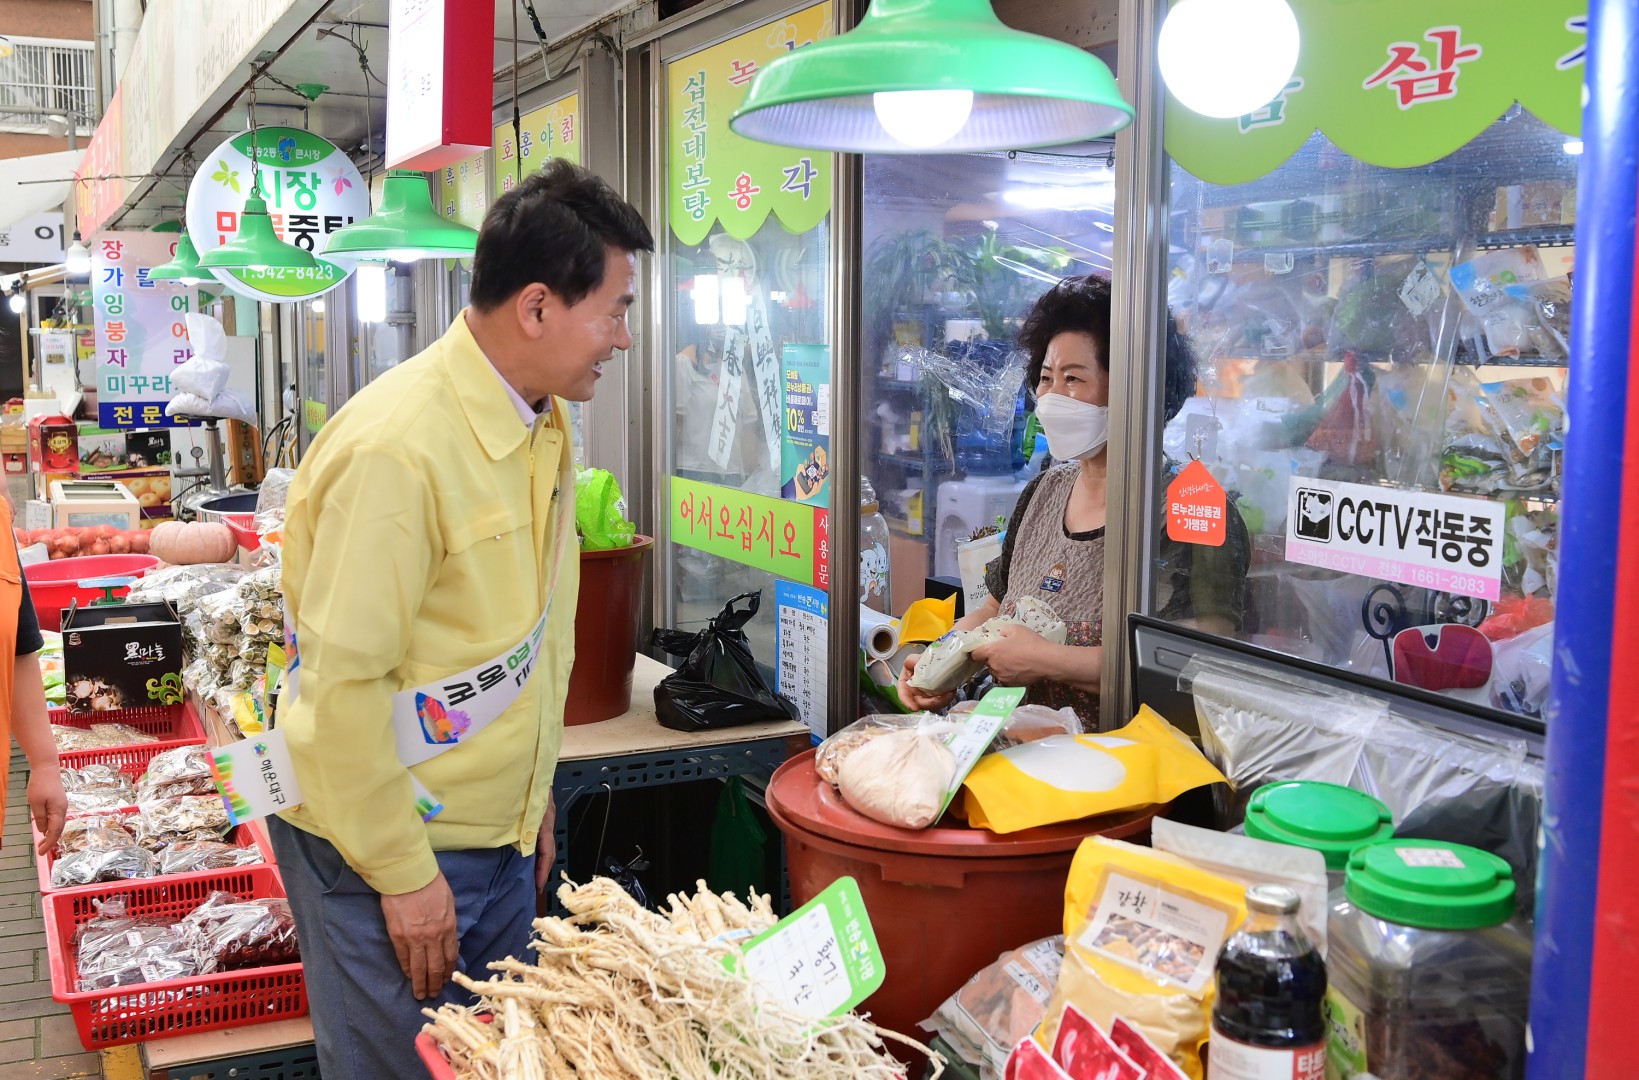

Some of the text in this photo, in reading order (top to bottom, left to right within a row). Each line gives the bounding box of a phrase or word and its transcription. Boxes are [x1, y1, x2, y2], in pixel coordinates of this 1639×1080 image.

[1366, 30, 1479, 106] 삼
[682, 71, 710, 219] 십전대보탕
[728, 173, 760, 209] 용
[781, 159, 817, 199] 각
[103, 268, 123, 287] 가
[104, 295, 189, 314] 잉 어
[105, 322, 126, 341] 붕
[107, 349, 127, 367] 자
[107, 376, 179, 394] 미꾸라
[113, 406, 132, 424] 전
[141, 406, 162, 422] 문
[1171, 503, 1221, 519] 온누리상품권
[681, 492, 800, 559] 어서오십시오
[1183, 518, 1209, 532] 가맹점
[1337, 497, 1493, 567] CCTV작동중
[1331, 554, 1366, 572] CCTV
[1411, 567, 1485, 594] 1661-2083
[261, 759, 286, 805] 해운대구
[1118, 890, 1147, 914] 강황
